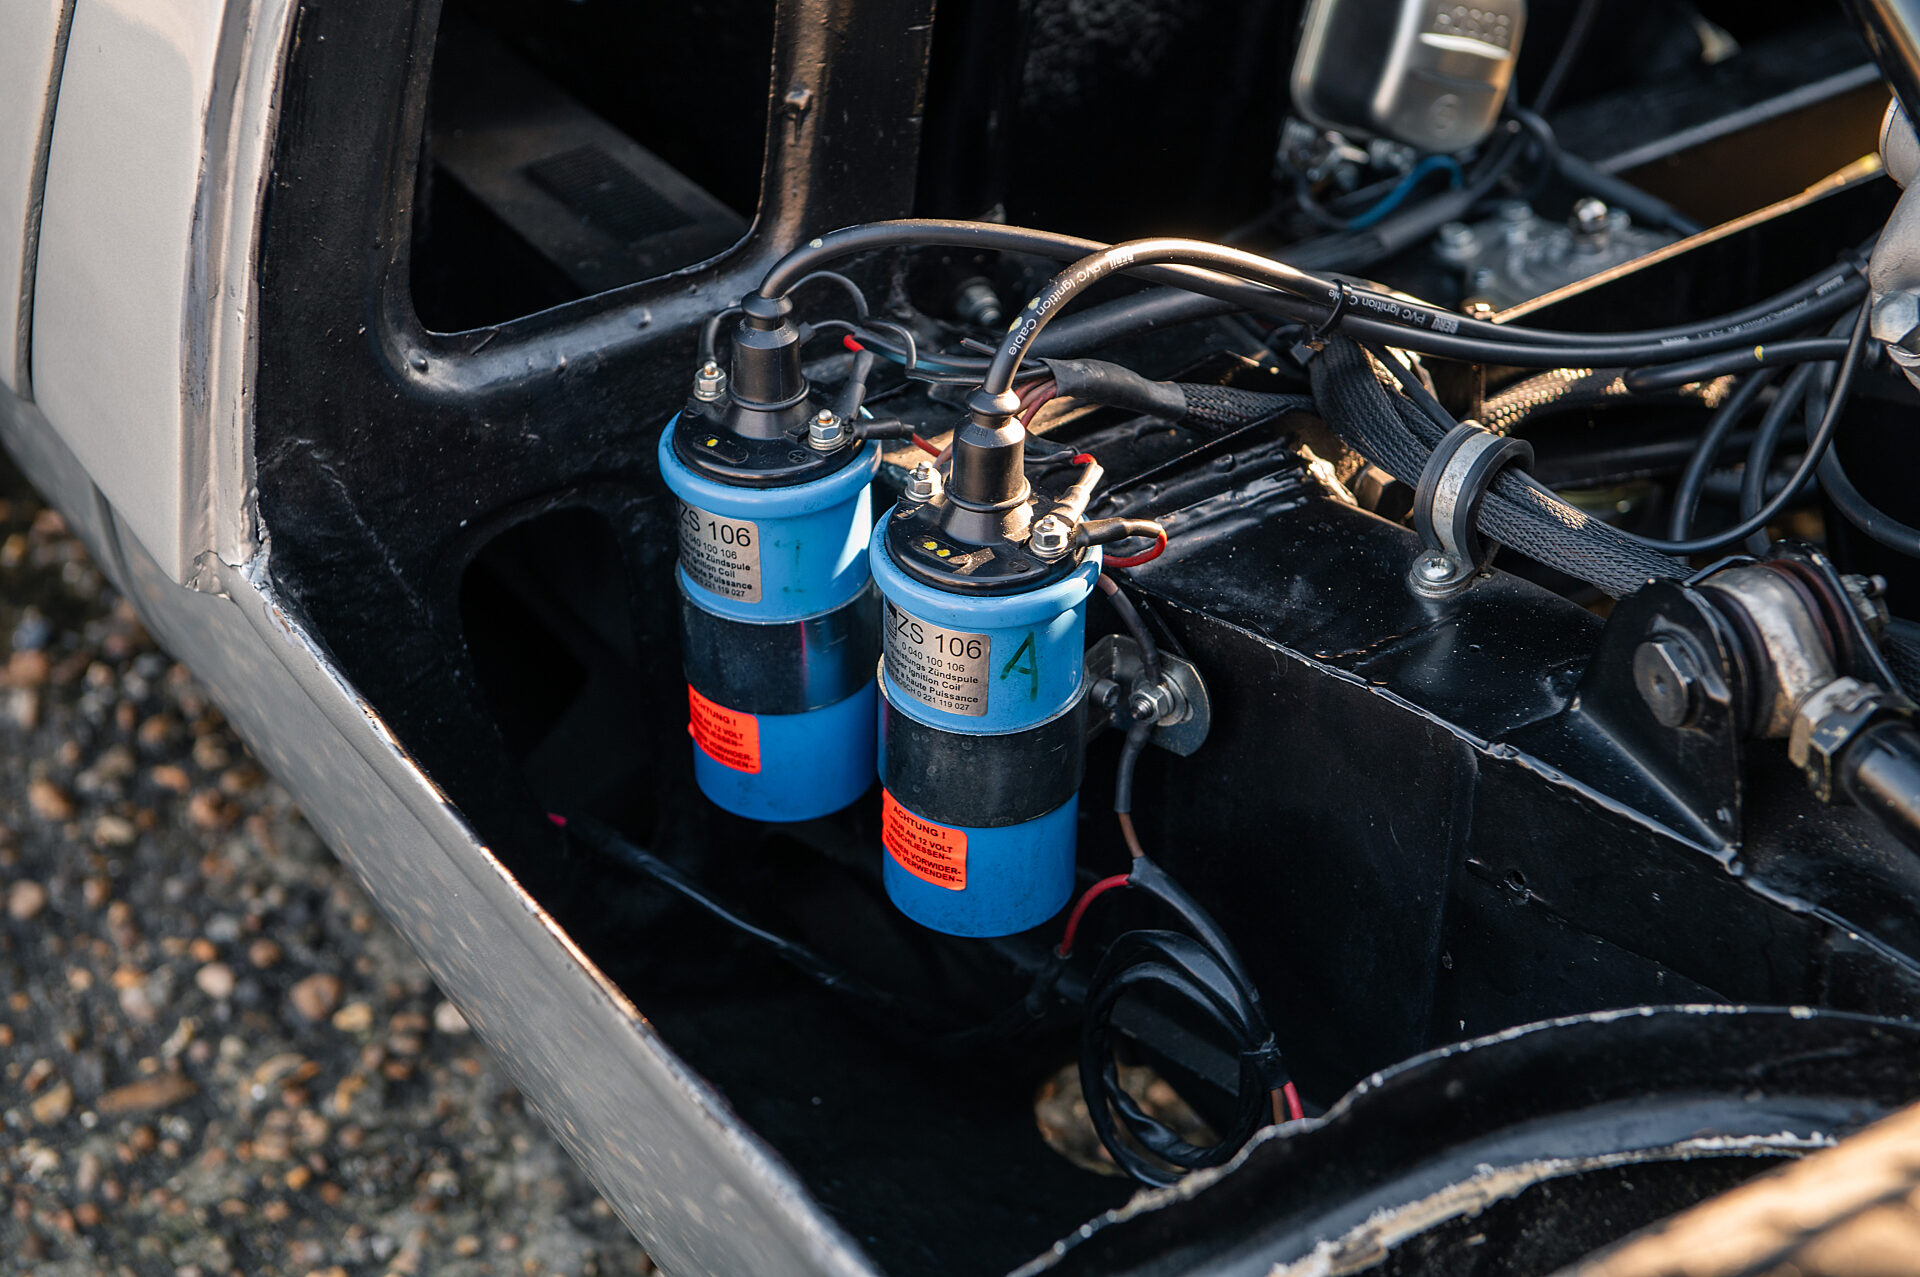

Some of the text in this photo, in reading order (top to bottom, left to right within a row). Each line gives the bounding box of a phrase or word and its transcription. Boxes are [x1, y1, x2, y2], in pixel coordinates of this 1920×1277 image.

[1077, 262, 1101, 282] PVC
[1036, 278, 1076, 316] Ignition
[1362, 297, 1400, 317] Ignition
[1402, 309, 1426, 326] PVC
[1008, 318, 1037, 356] Cable
[680, 502, 700, 532] ZS
[708, 521, 751, 547] 106
[703, 542, 718, 555] 100
[721, 549, 737, 560] 106
[705, 553, 751, 571] Zündspule
[718, 568, 735, 578] Coil
[898, 612, 923, 644] ZS
[935, 634, 982, 660] 106
[901, 641, 965, 672] 0 040 100 106
[1000, 631, 1038, 702] A
[909, 666, 939, 686] Ignition
[942, 681, 961, 691] Coil
[928, 667, 979, 684] Zündspule
[906, 674, 927, 691] haute
[930, 687, 979, 703] Puissance
[923, 694, 936, 703] 221
[939, 700, 953, 708] 119
[955, 703, 970, 711] 027
[893, 805, 946, 839] ACHTUNG !
[906, 830, 916, 840] AN
[919, 837, 928, 846] 12
[929, 841, 953, 853] VOLT
